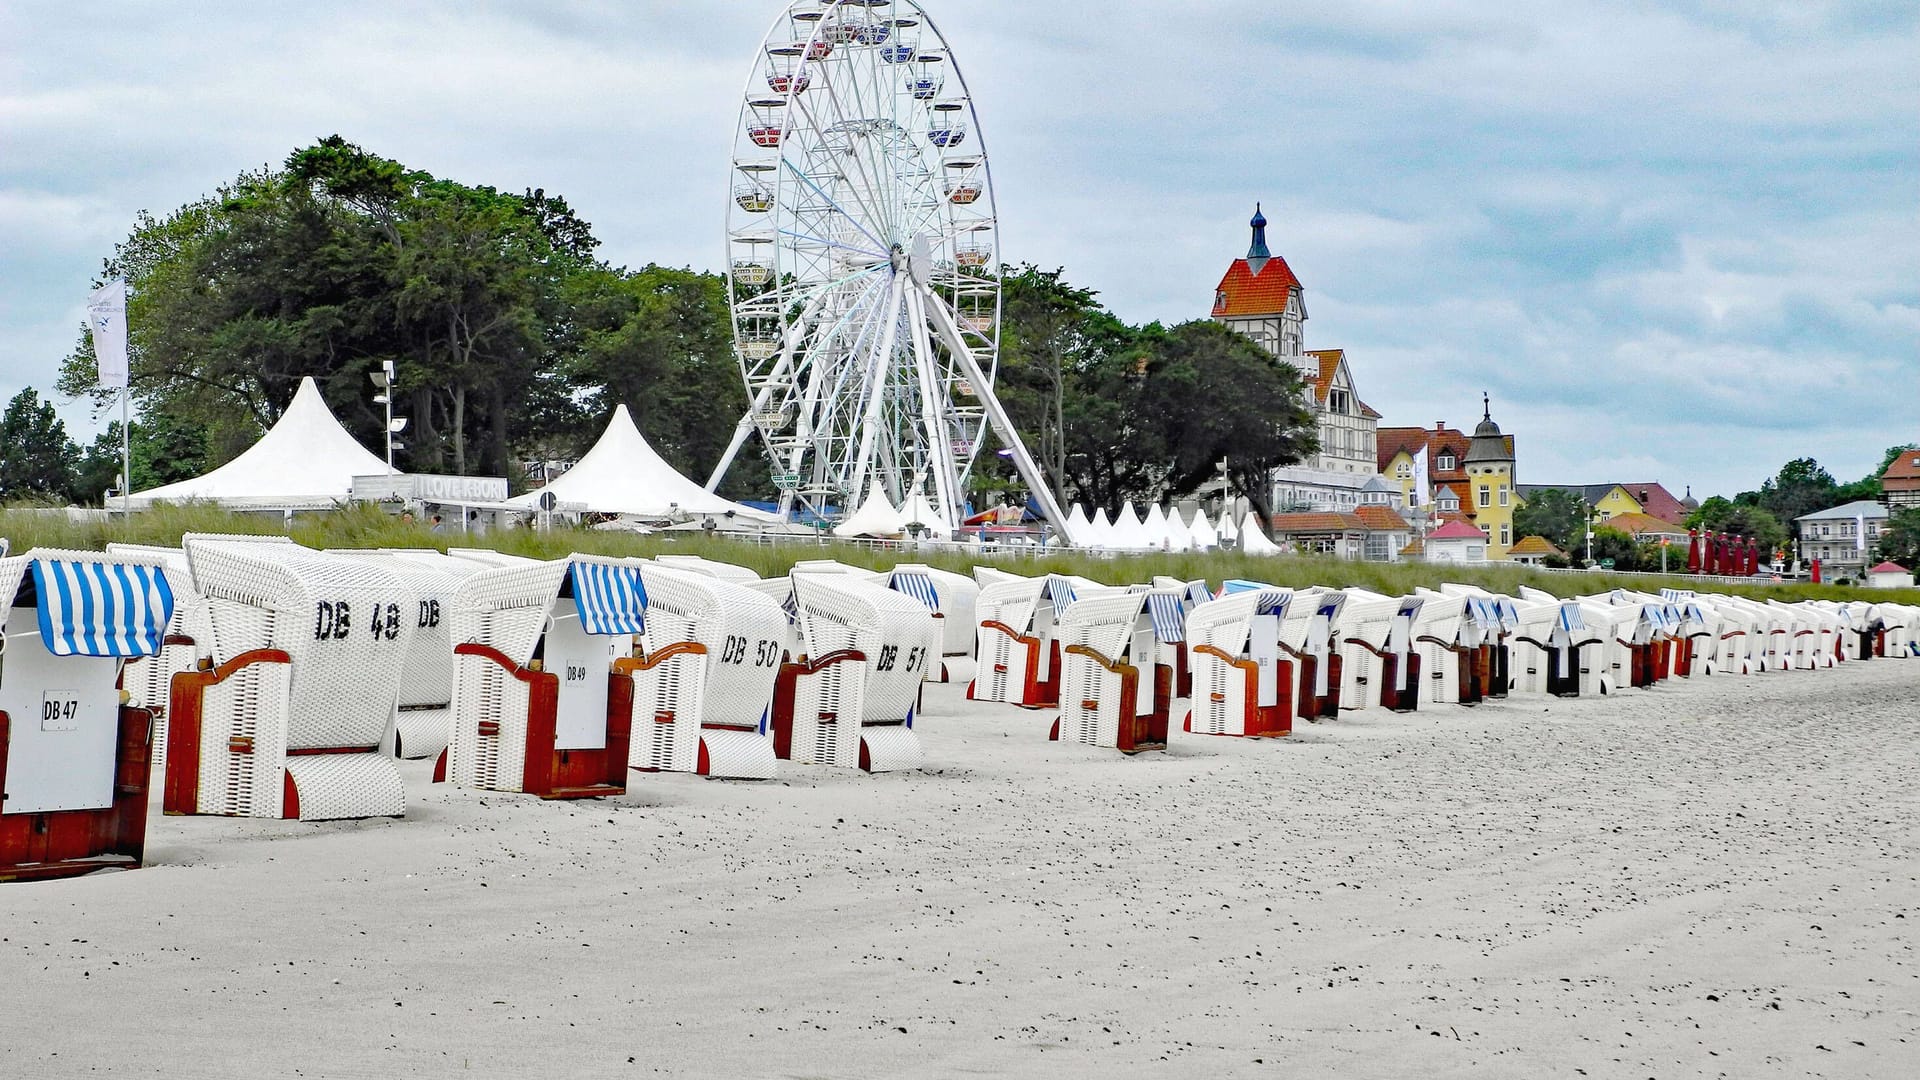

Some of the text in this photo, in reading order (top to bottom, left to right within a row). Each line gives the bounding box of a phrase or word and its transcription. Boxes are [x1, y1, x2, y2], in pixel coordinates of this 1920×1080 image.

[426, 475, 460, 499] LOVE
[315, 600, 400, 640] DB 48
[418, 599, 440, 628] DB
[721, 634, 778, 667] DB 50
[877, 643, 926, 672] DB 51
[567, 666, 586, 681] DB 49
[44, 700, 78, 720] DB 47
